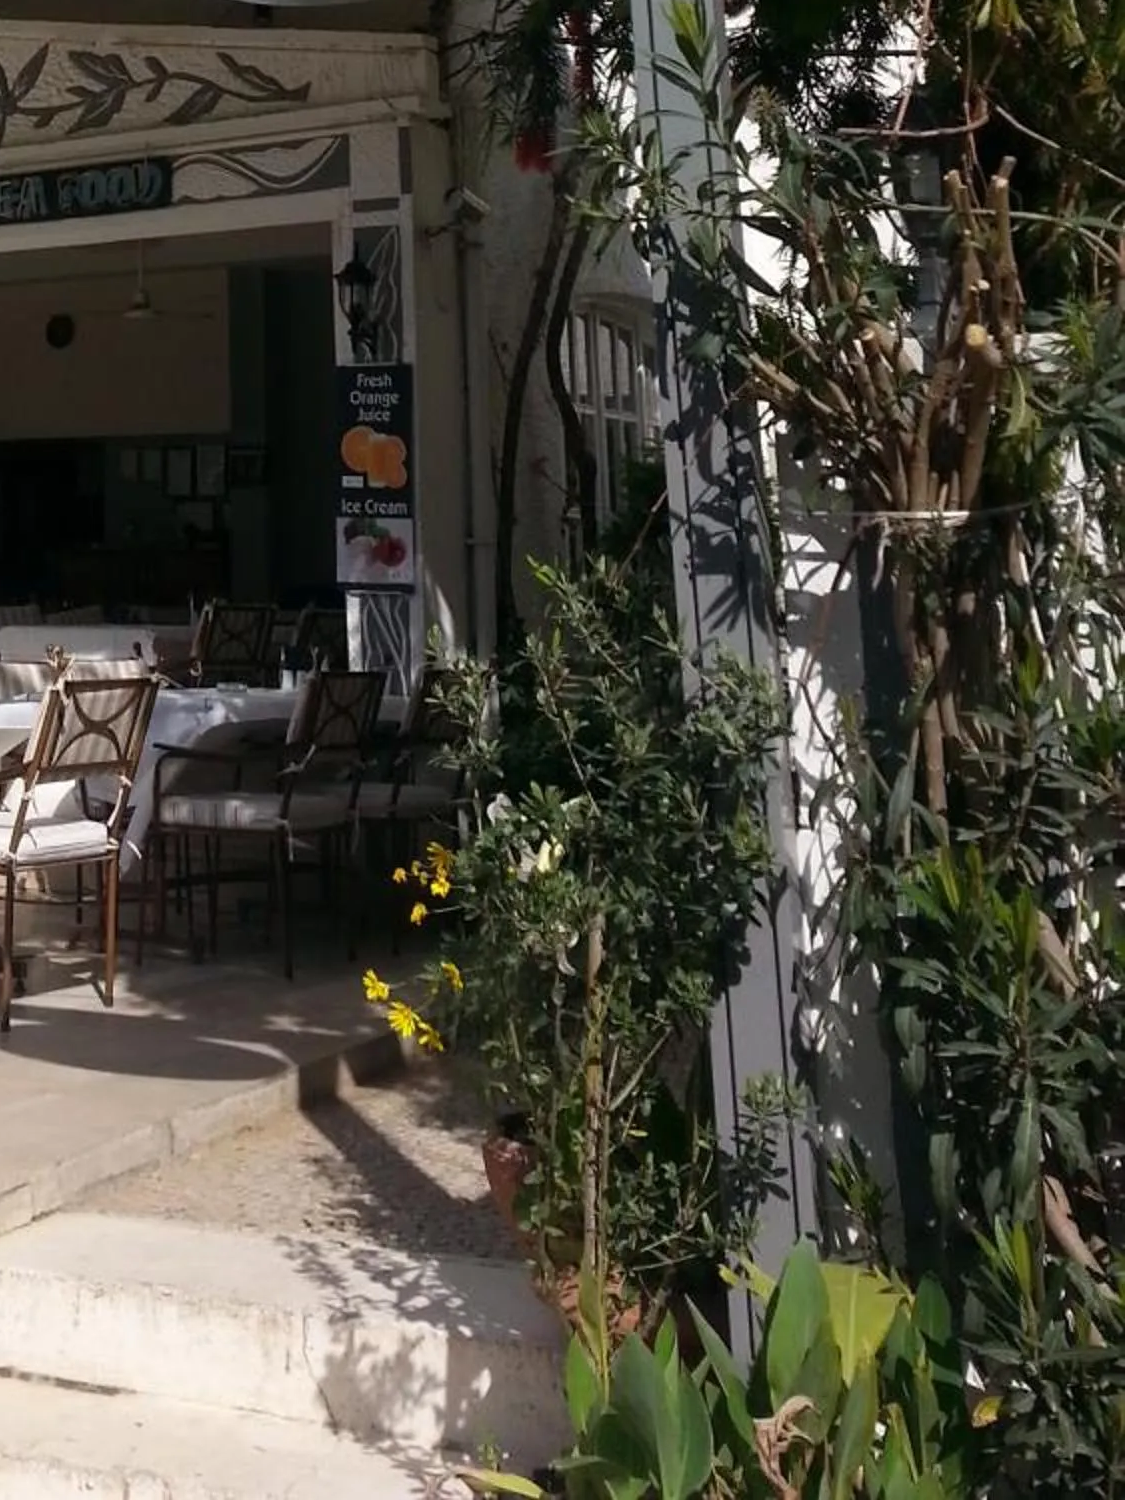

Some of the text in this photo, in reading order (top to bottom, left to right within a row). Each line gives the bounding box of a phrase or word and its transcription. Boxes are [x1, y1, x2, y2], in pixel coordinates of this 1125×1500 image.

[356, 373, 392, 388] Fresh
[350, 391, 400, 408] Orange
[356, 407, 391, 422] Juice
[341, 498, 408, 515] Ice Cream
